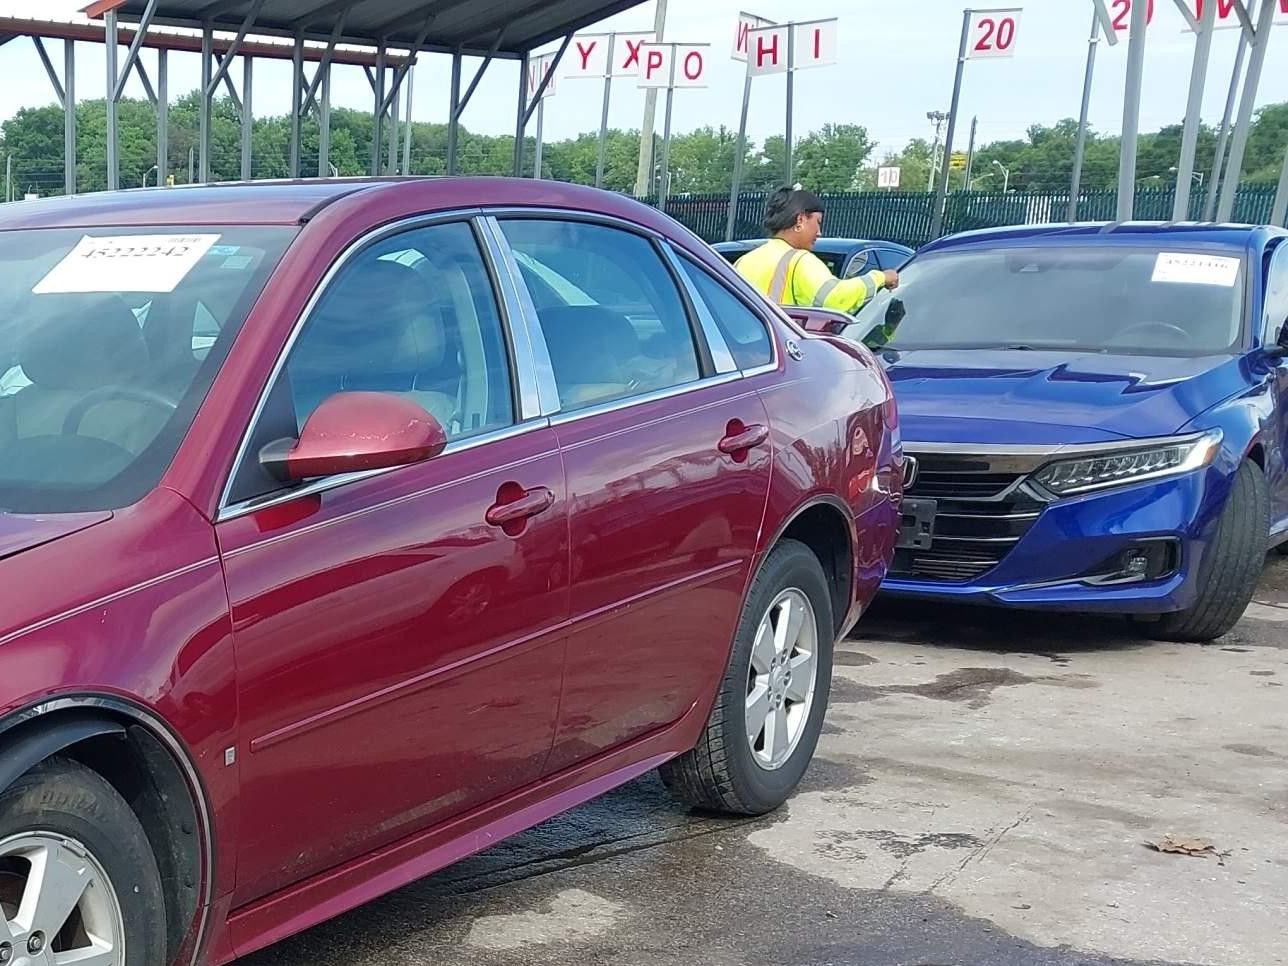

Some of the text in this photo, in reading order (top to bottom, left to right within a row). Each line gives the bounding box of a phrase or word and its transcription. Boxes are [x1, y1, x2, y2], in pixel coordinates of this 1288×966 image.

[757, 28, 821, 67] H I
[974, 18, 1015, 51] 20
[576, 40, 645, 70] Y X
[647, 51, 703, 80] P O
[81, 246, 191, 259] 45222242
